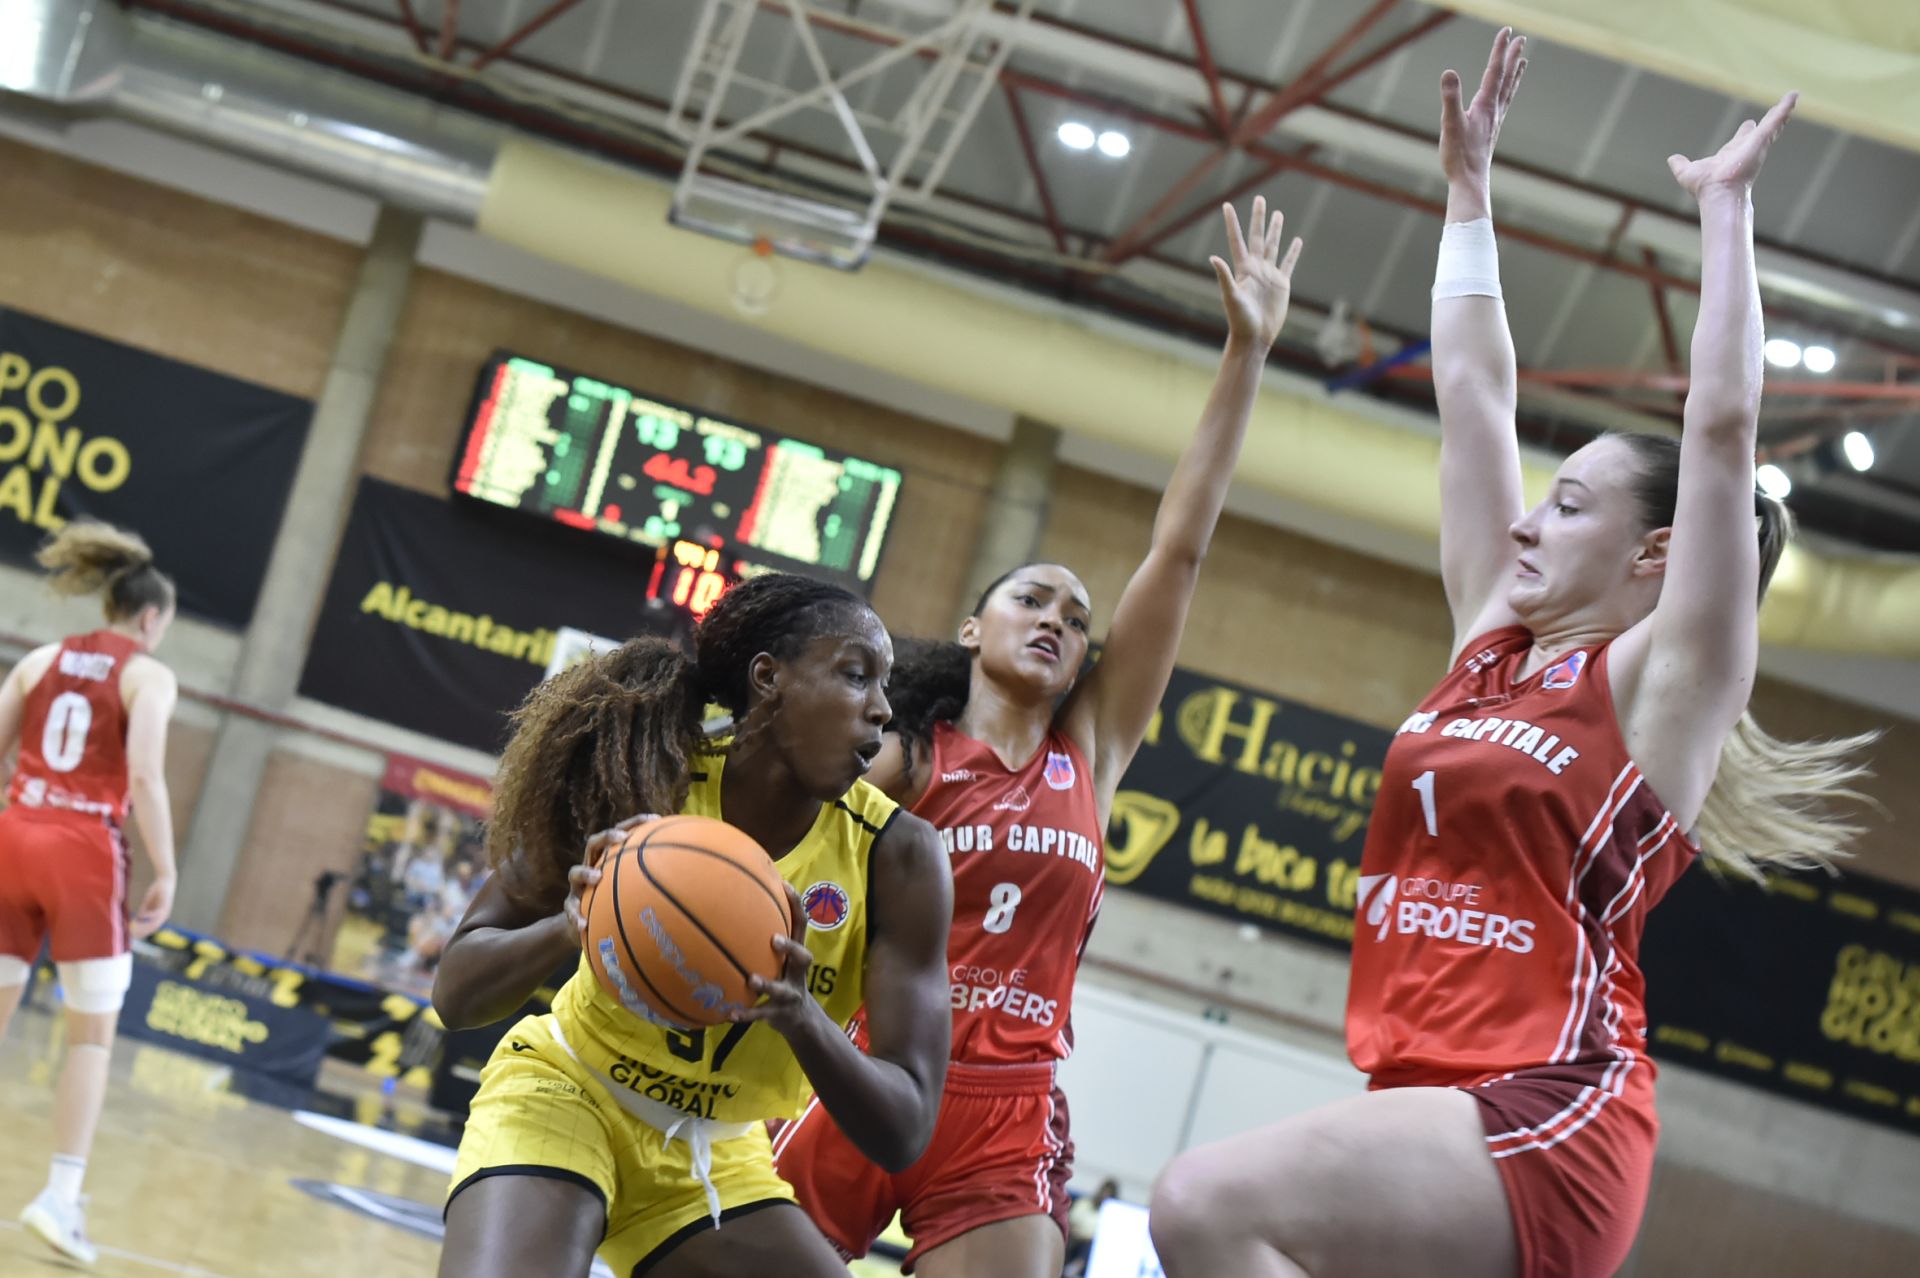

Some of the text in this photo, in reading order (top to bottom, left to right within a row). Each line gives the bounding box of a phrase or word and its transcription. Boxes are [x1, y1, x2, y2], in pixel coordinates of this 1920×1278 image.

[41, 690, 94, 773] 0
[1440, 717, 1580, 775] CAPITALE
[1411, 770, 1438, 837] 1
[1007, 823, 1098, 874] CAPITALE
[982, 881, 1022, 934] 8
[1400, 877, 1483, 906] GROUPE
[1397, 901, 1537, 954] BROERS
[609, 1063, 718, 1121] GLOBAL
